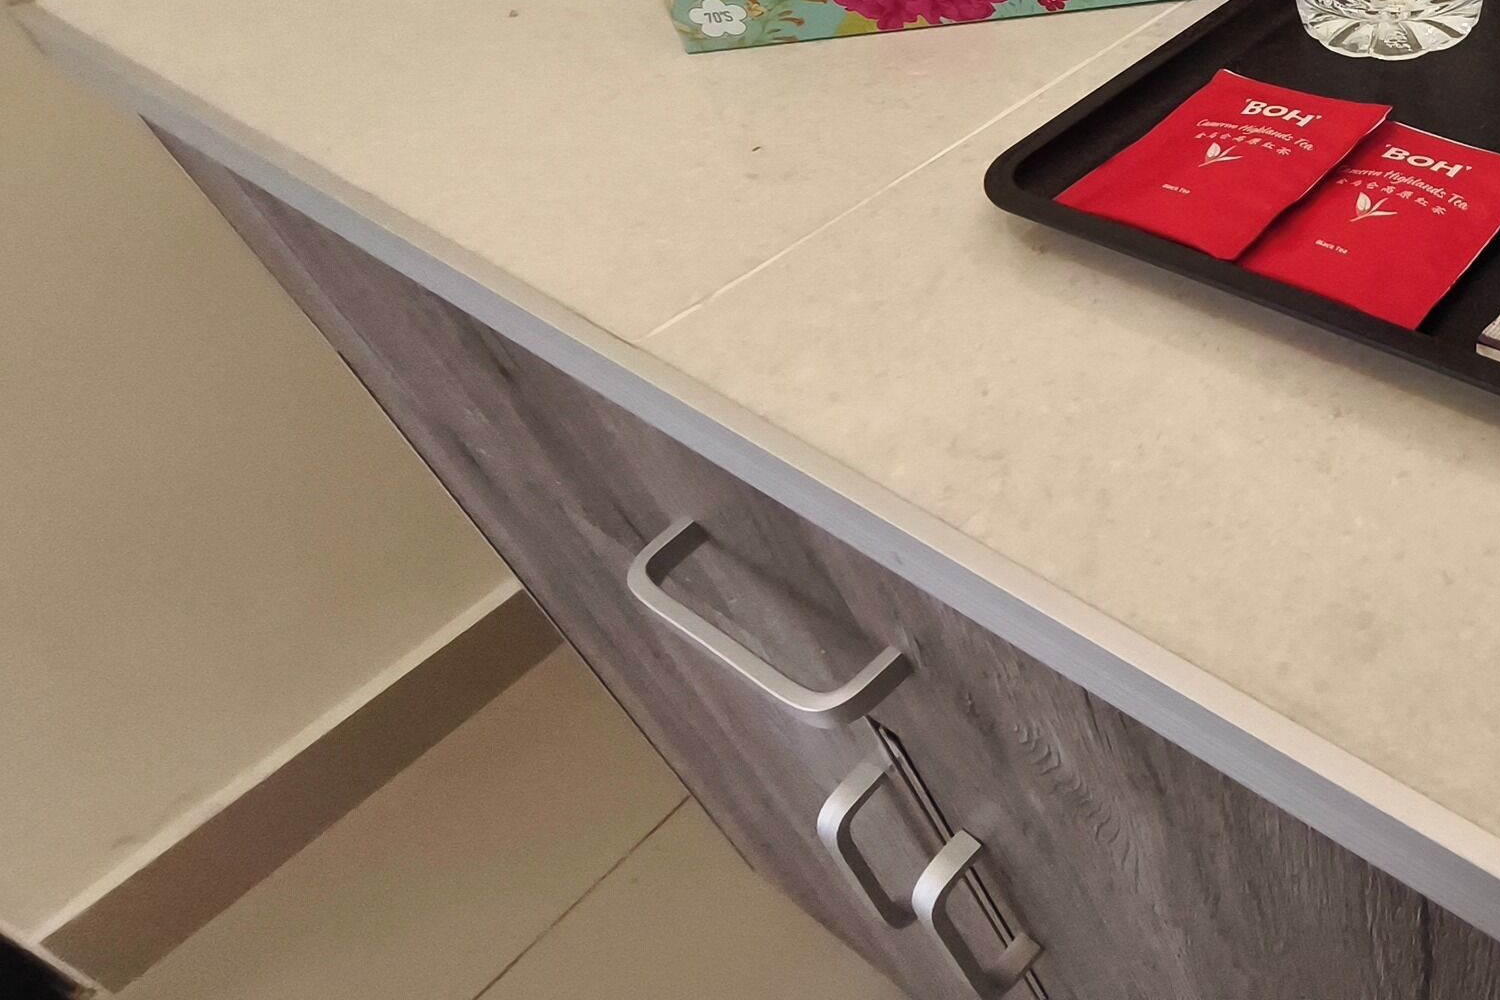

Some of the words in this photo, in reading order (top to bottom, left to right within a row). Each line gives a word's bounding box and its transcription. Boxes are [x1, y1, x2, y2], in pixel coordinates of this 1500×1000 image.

[1238, 123, 1294, 142] Highlands
[1294, 137, 1314, 151] Tea
[1383, 169, 1447, 200] Highlands
[1447, 192, 1470, 211] Tea
